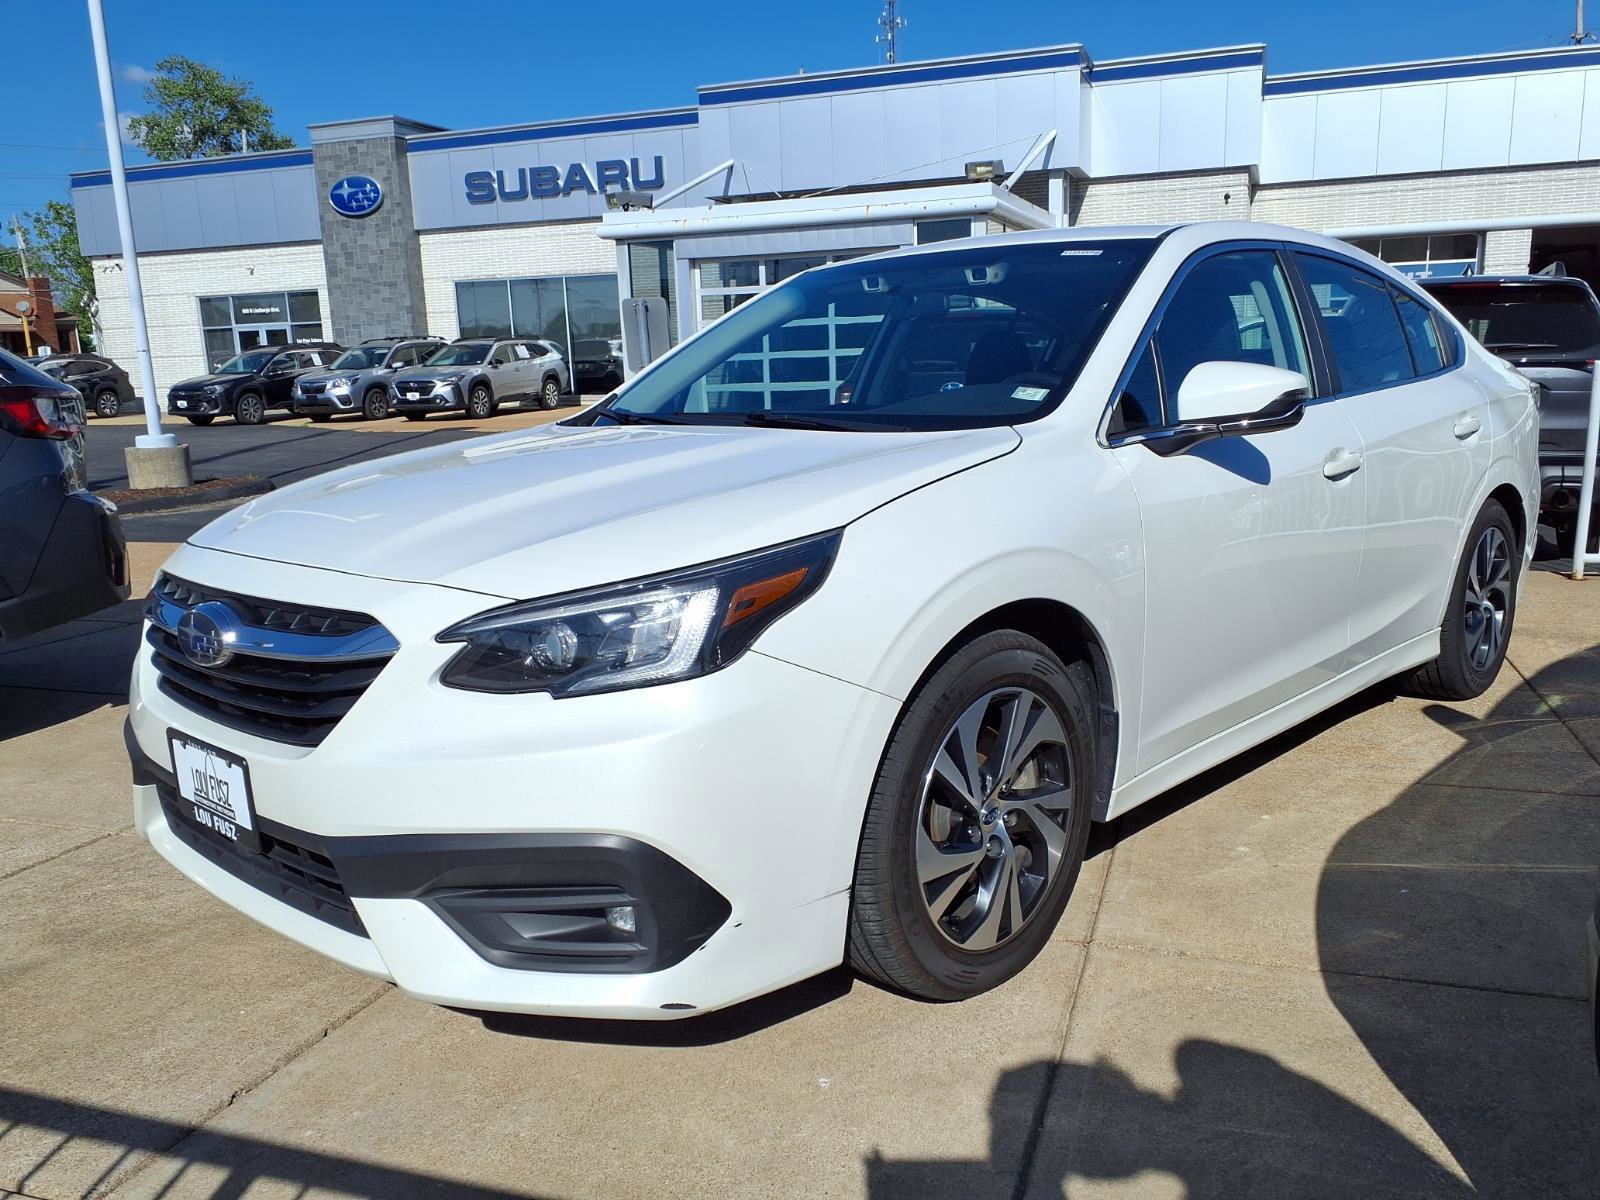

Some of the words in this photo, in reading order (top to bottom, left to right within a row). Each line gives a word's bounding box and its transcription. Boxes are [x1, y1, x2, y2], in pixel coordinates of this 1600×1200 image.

[464, 155, 665, 204] SUBARU
[191, 766, 206, 796] LOU
[209, 774, 232, 808] FUSZ
[194, 805, 212, 828] LOU
[213, 815, 238, 841] FUSZ
